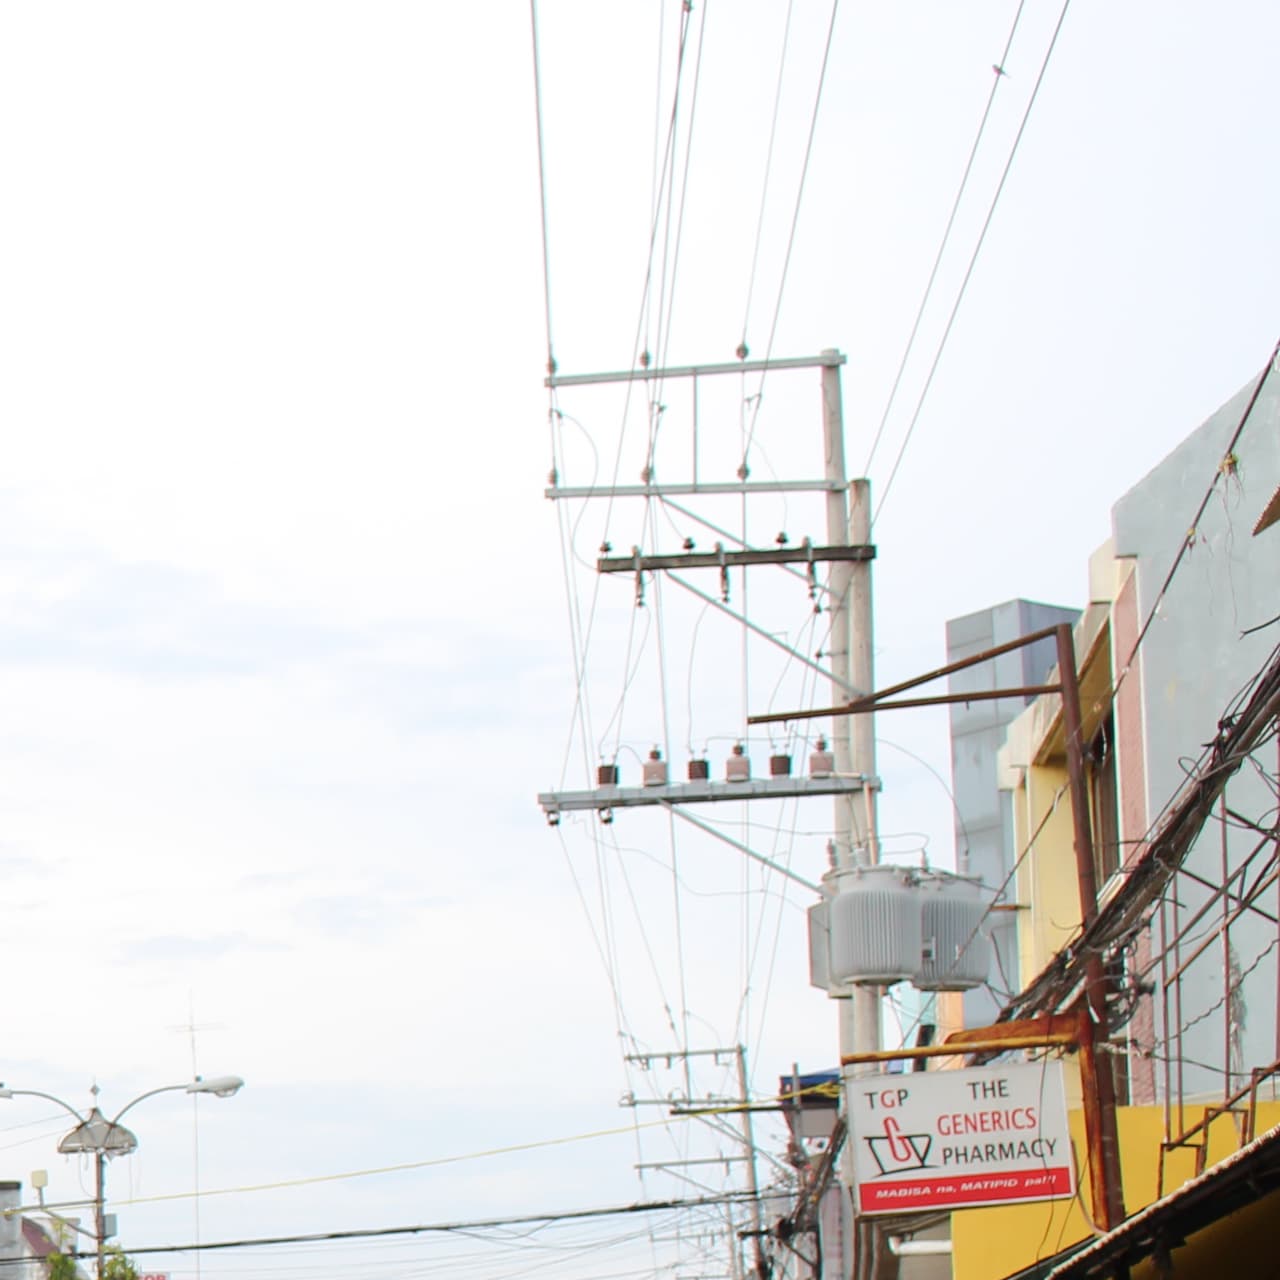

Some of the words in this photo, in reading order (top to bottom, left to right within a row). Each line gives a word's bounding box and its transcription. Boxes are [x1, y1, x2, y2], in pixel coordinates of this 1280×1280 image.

[864, 1089, 909, 1109] TGP
[967, 1079, 1009, 1100] THE
[937, 1107, 1037, 1136] GENERICS
[942, 1137, 1057, 1165] PHARMACY
[875, 1185, 932, 1199] MABISA
[960, 1178, 1018, 1191] MATIPID
